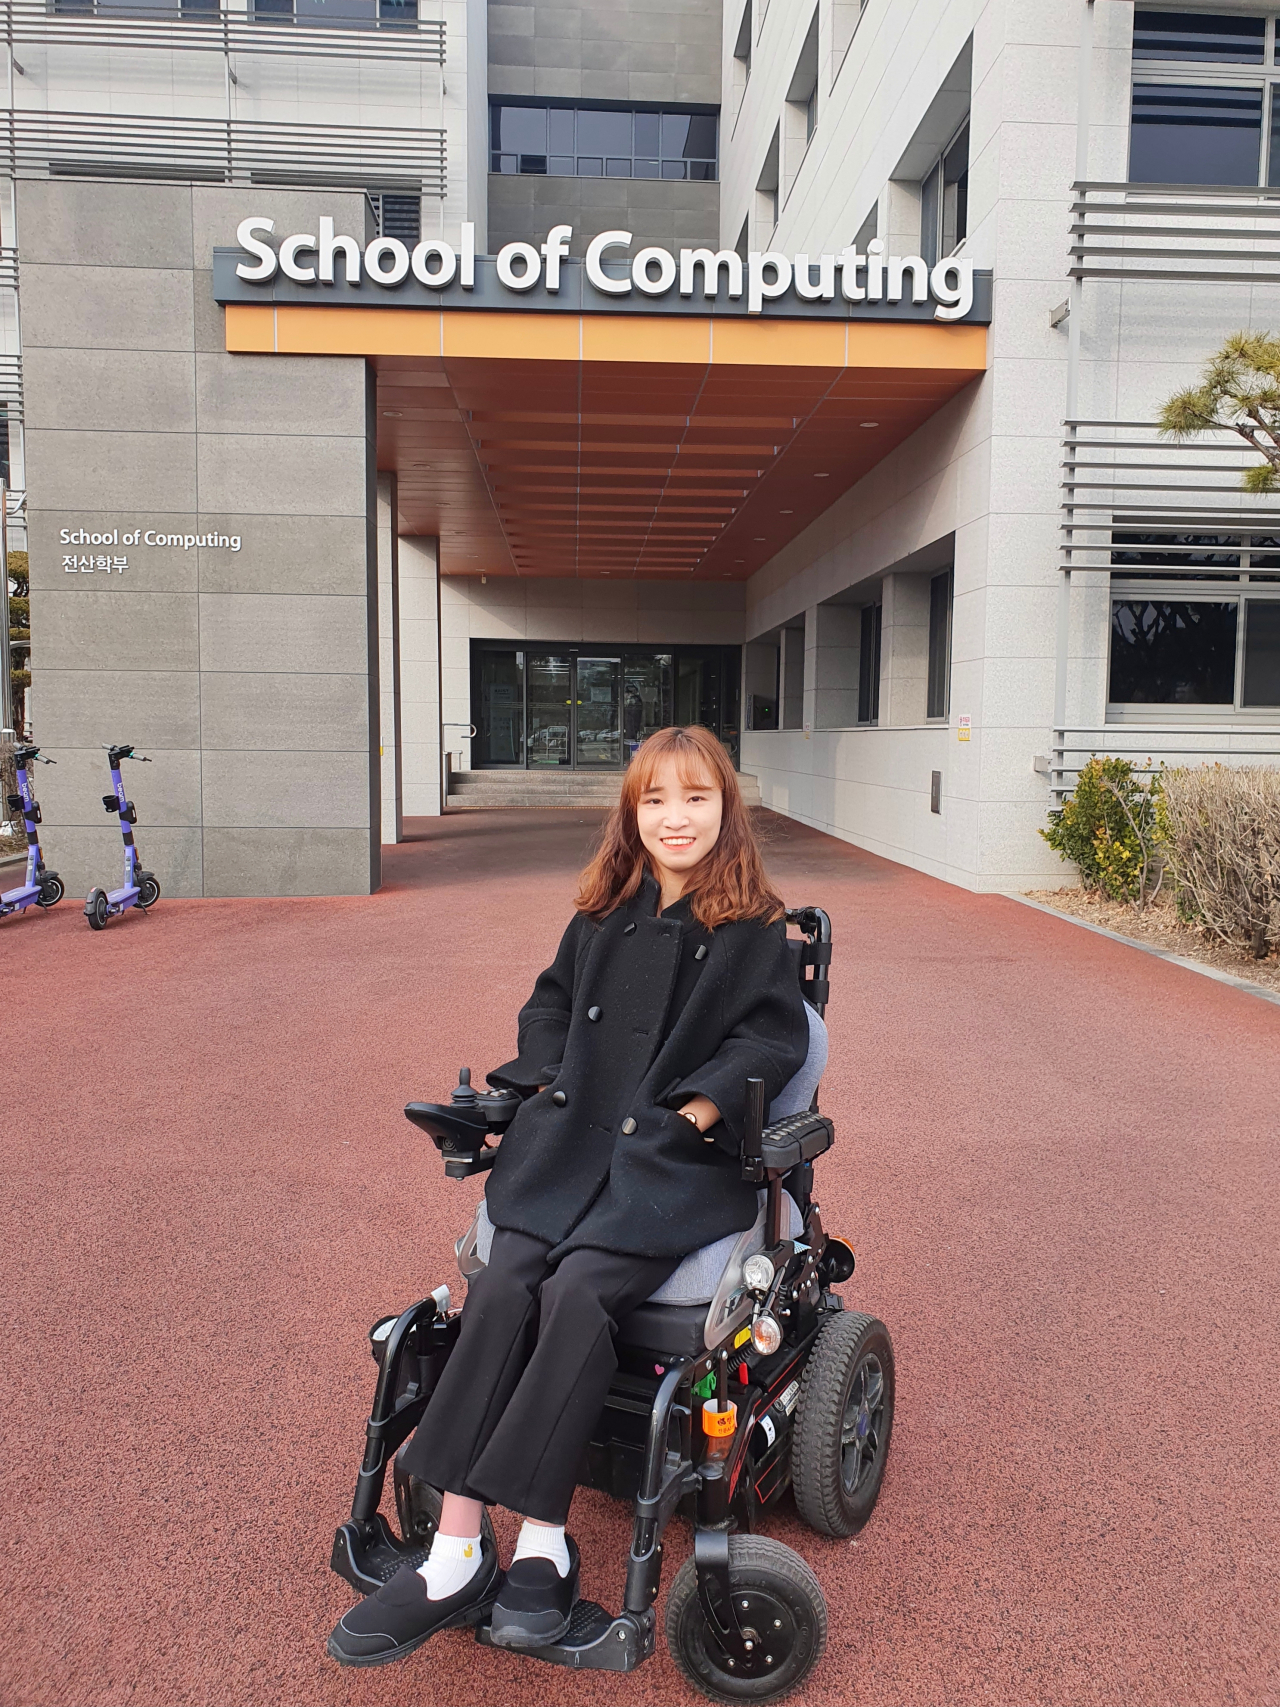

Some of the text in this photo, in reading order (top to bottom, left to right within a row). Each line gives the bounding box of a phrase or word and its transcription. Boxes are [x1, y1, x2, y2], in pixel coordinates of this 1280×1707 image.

[235, 216, 973, 322] School of Computing
[60, 528, 242, 551] School of Computing
[61, 555, 129, 574] 전산학부
